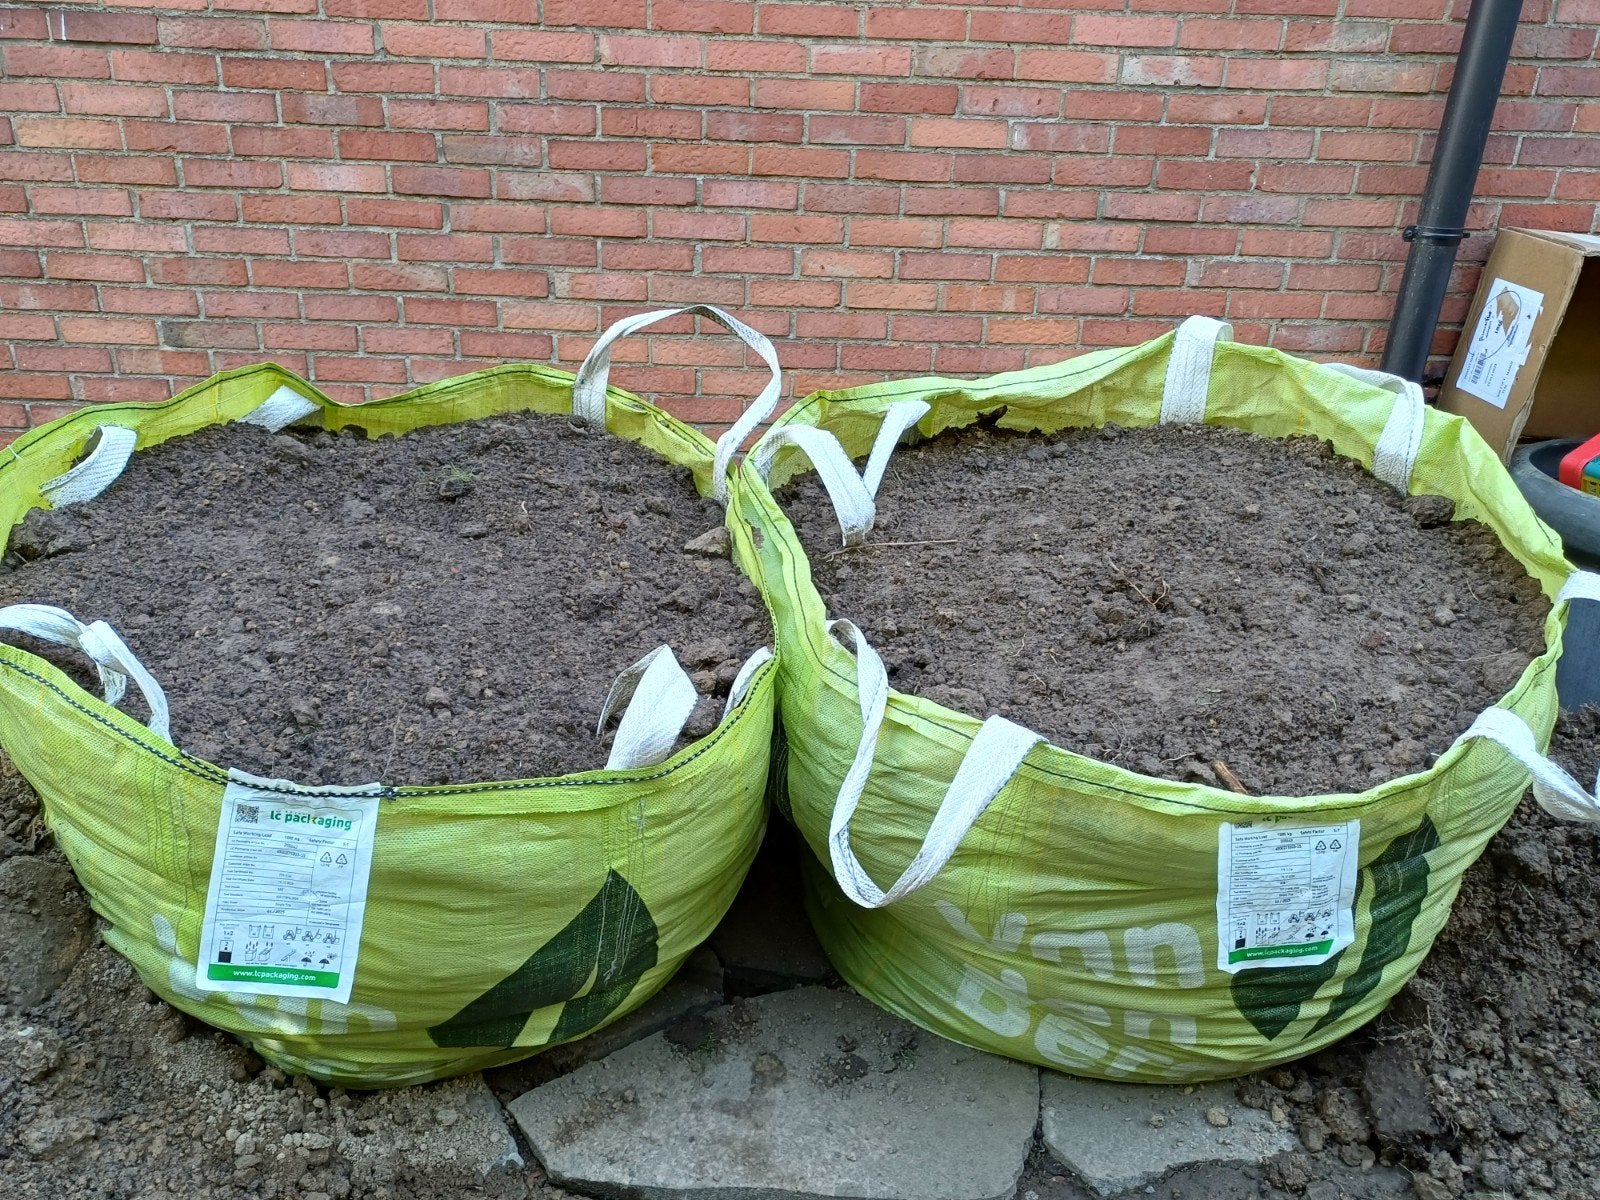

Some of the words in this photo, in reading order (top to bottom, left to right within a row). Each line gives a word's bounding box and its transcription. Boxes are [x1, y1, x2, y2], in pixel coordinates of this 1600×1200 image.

[270, 810, 282, 820] lc
[284, 812, 352, 831] packaging
[1246, 946, 1318, 957] www.lcpackaging.com
[233, 969, 317, 981] www.lcpackaging.com
